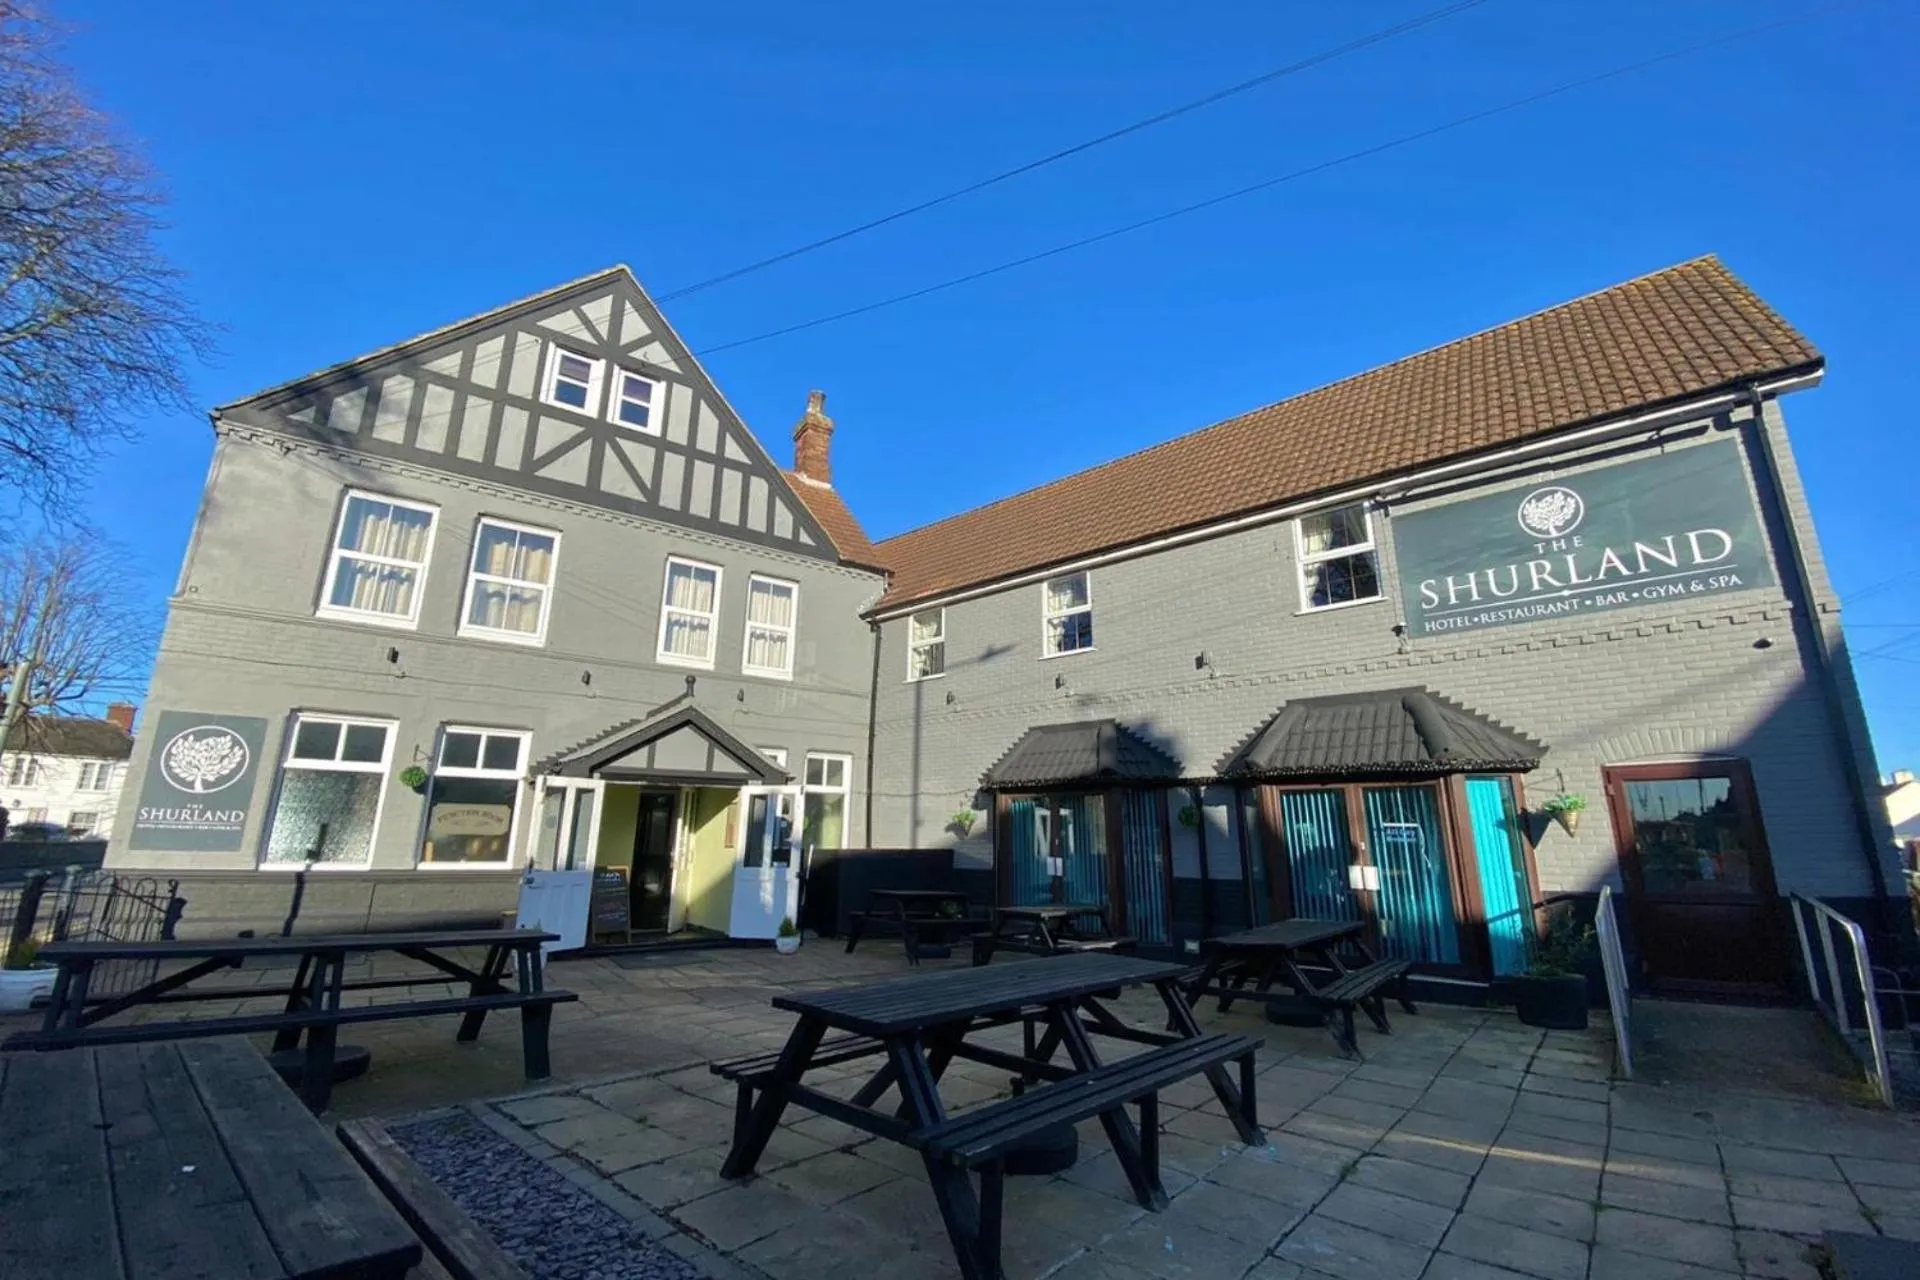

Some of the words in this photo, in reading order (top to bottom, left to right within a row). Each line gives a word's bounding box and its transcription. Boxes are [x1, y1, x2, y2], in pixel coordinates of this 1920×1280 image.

[1534, 535, 1584, 554] THE
[1420, 528, 1733, 609] SHURLAND
[1595, 591, 1630, 606] BAR
[1642, 582, 1687, 599] GYM
[1690, 579, 1706, 593] &
[1709, 573, 1744, 589] SPA
[139, 807, 245, 822] SHURLAND
